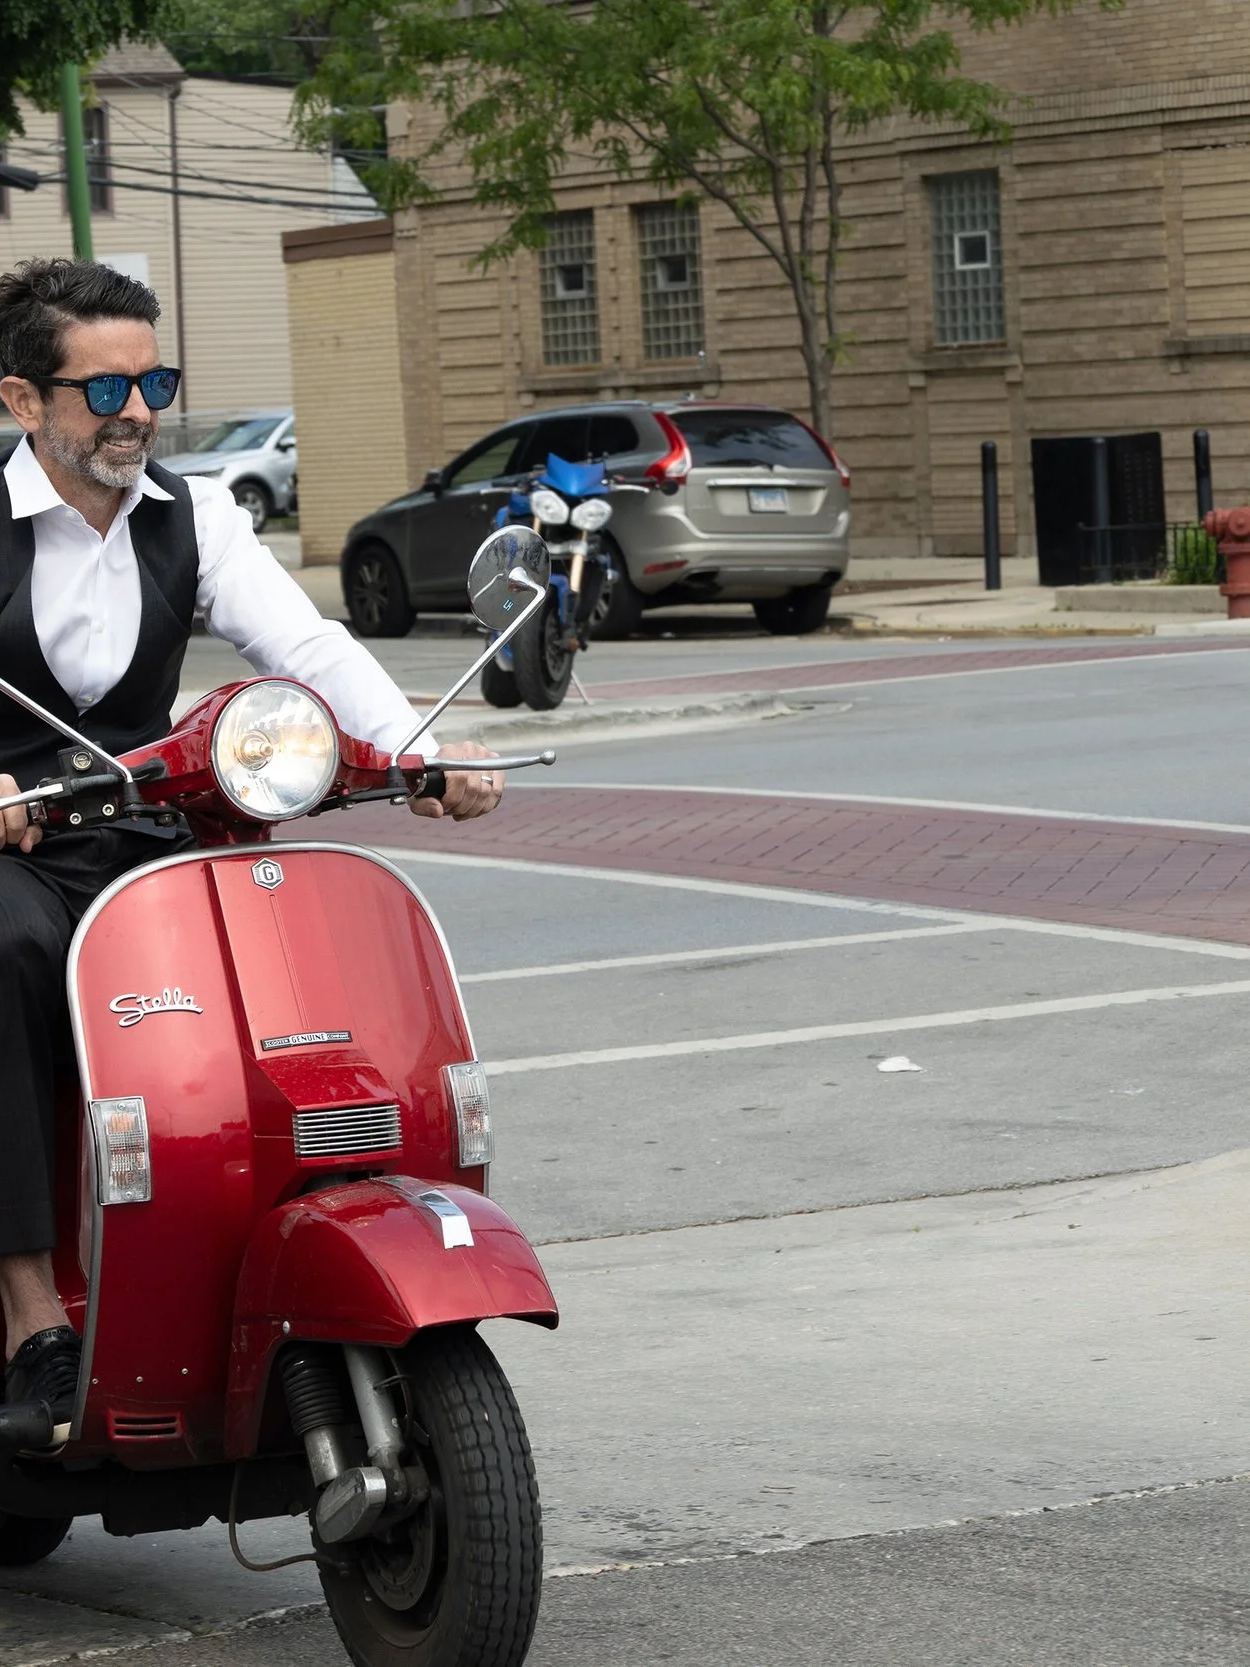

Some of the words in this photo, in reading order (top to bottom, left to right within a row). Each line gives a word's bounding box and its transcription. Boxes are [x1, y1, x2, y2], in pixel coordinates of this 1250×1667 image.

[262, 865, 274, 881] G
[109, 987, 204, 1027] Stella
[291, 1033, 326, 1045] GENUINE
